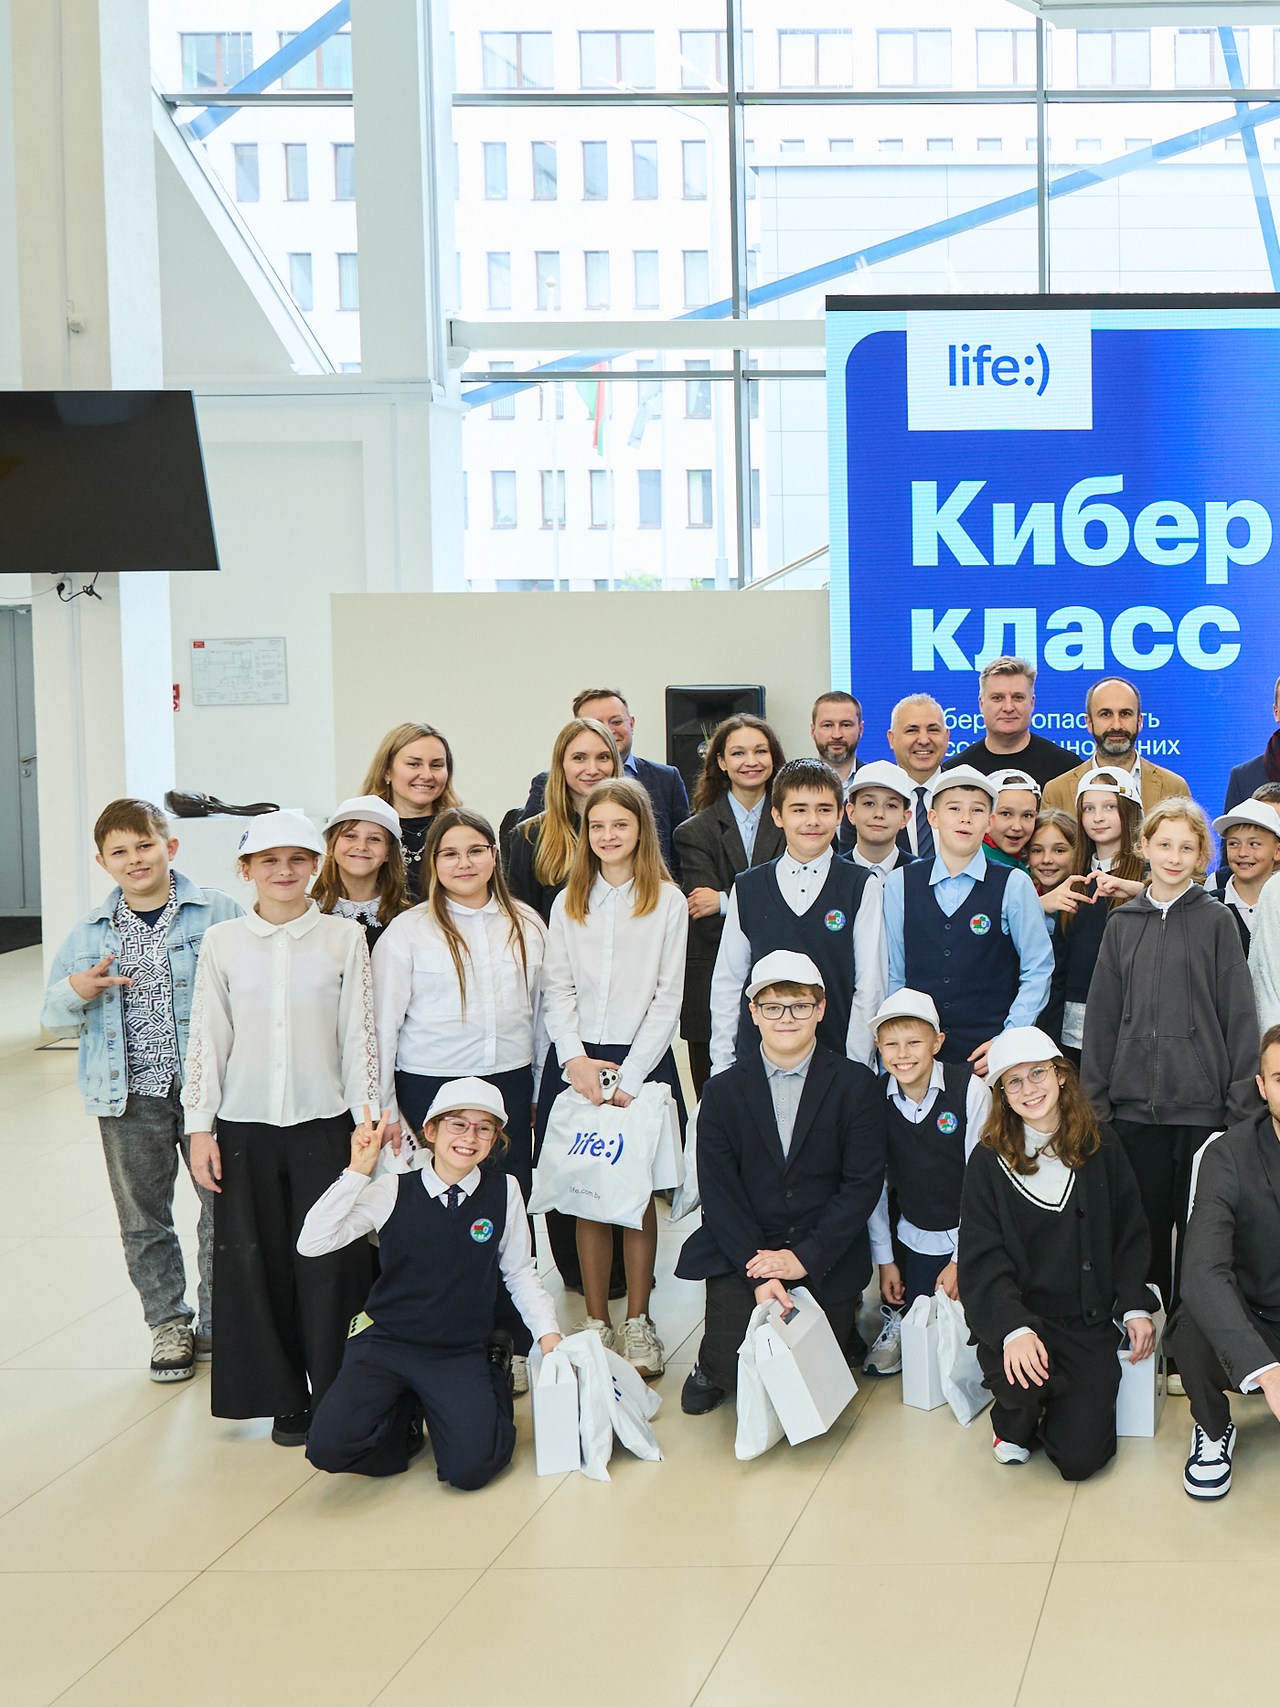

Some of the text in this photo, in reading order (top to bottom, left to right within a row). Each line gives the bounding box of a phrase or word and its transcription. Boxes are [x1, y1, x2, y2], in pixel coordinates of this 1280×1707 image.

[948, 343, 1050, 396] life:)
[911, 474, 1273, 585] Кибер
[911, 605, 1242, 672] класс
[567, 1132, 624, 1166] life:)
